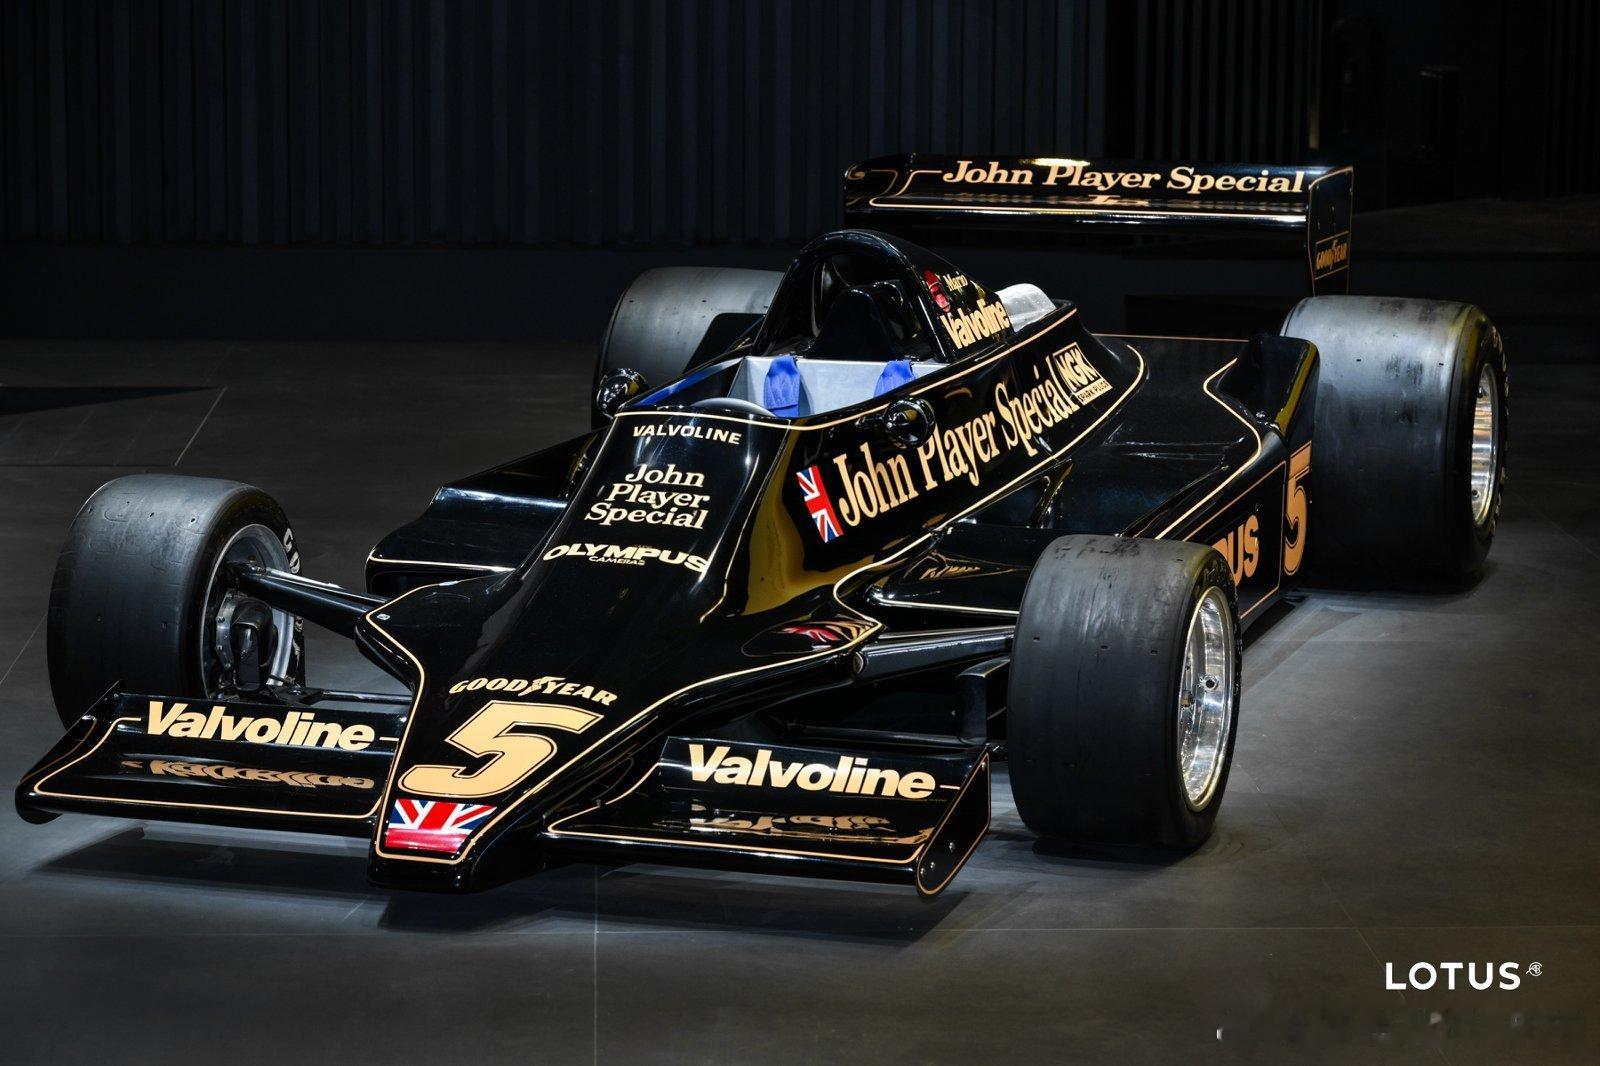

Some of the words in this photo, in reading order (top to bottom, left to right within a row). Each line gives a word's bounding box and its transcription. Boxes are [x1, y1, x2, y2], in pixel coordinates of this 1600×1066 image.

[943, 160, 1034, 186] John
[1042, 164, 1162, 191] Player
[1166, 169, 1305, 194] Special
[940, 298, 1011, 350] Valvoline
[1055, 348, 1099, 392] NGK
[633, 424, 742, 445] VALVOLINE
[833, 441, 919, 528] John
[917, 410, 1001, 487] Player
[995, 355, 1080, 458] Special
[625, 463, 706, 487] John
[584, 502, 709, 530] Special
[604, 483, 711, 510] Player
[1284, 440, 1312, 577] 5
[543, 543, 711, 573] OLYMPUS
[449, 676, 618, 706] GOODYEAR
[147, 700, 375, 751] Valvoline
[397, 699, 605, 799] 5
[688, 743, 936, 800] Valvoline
